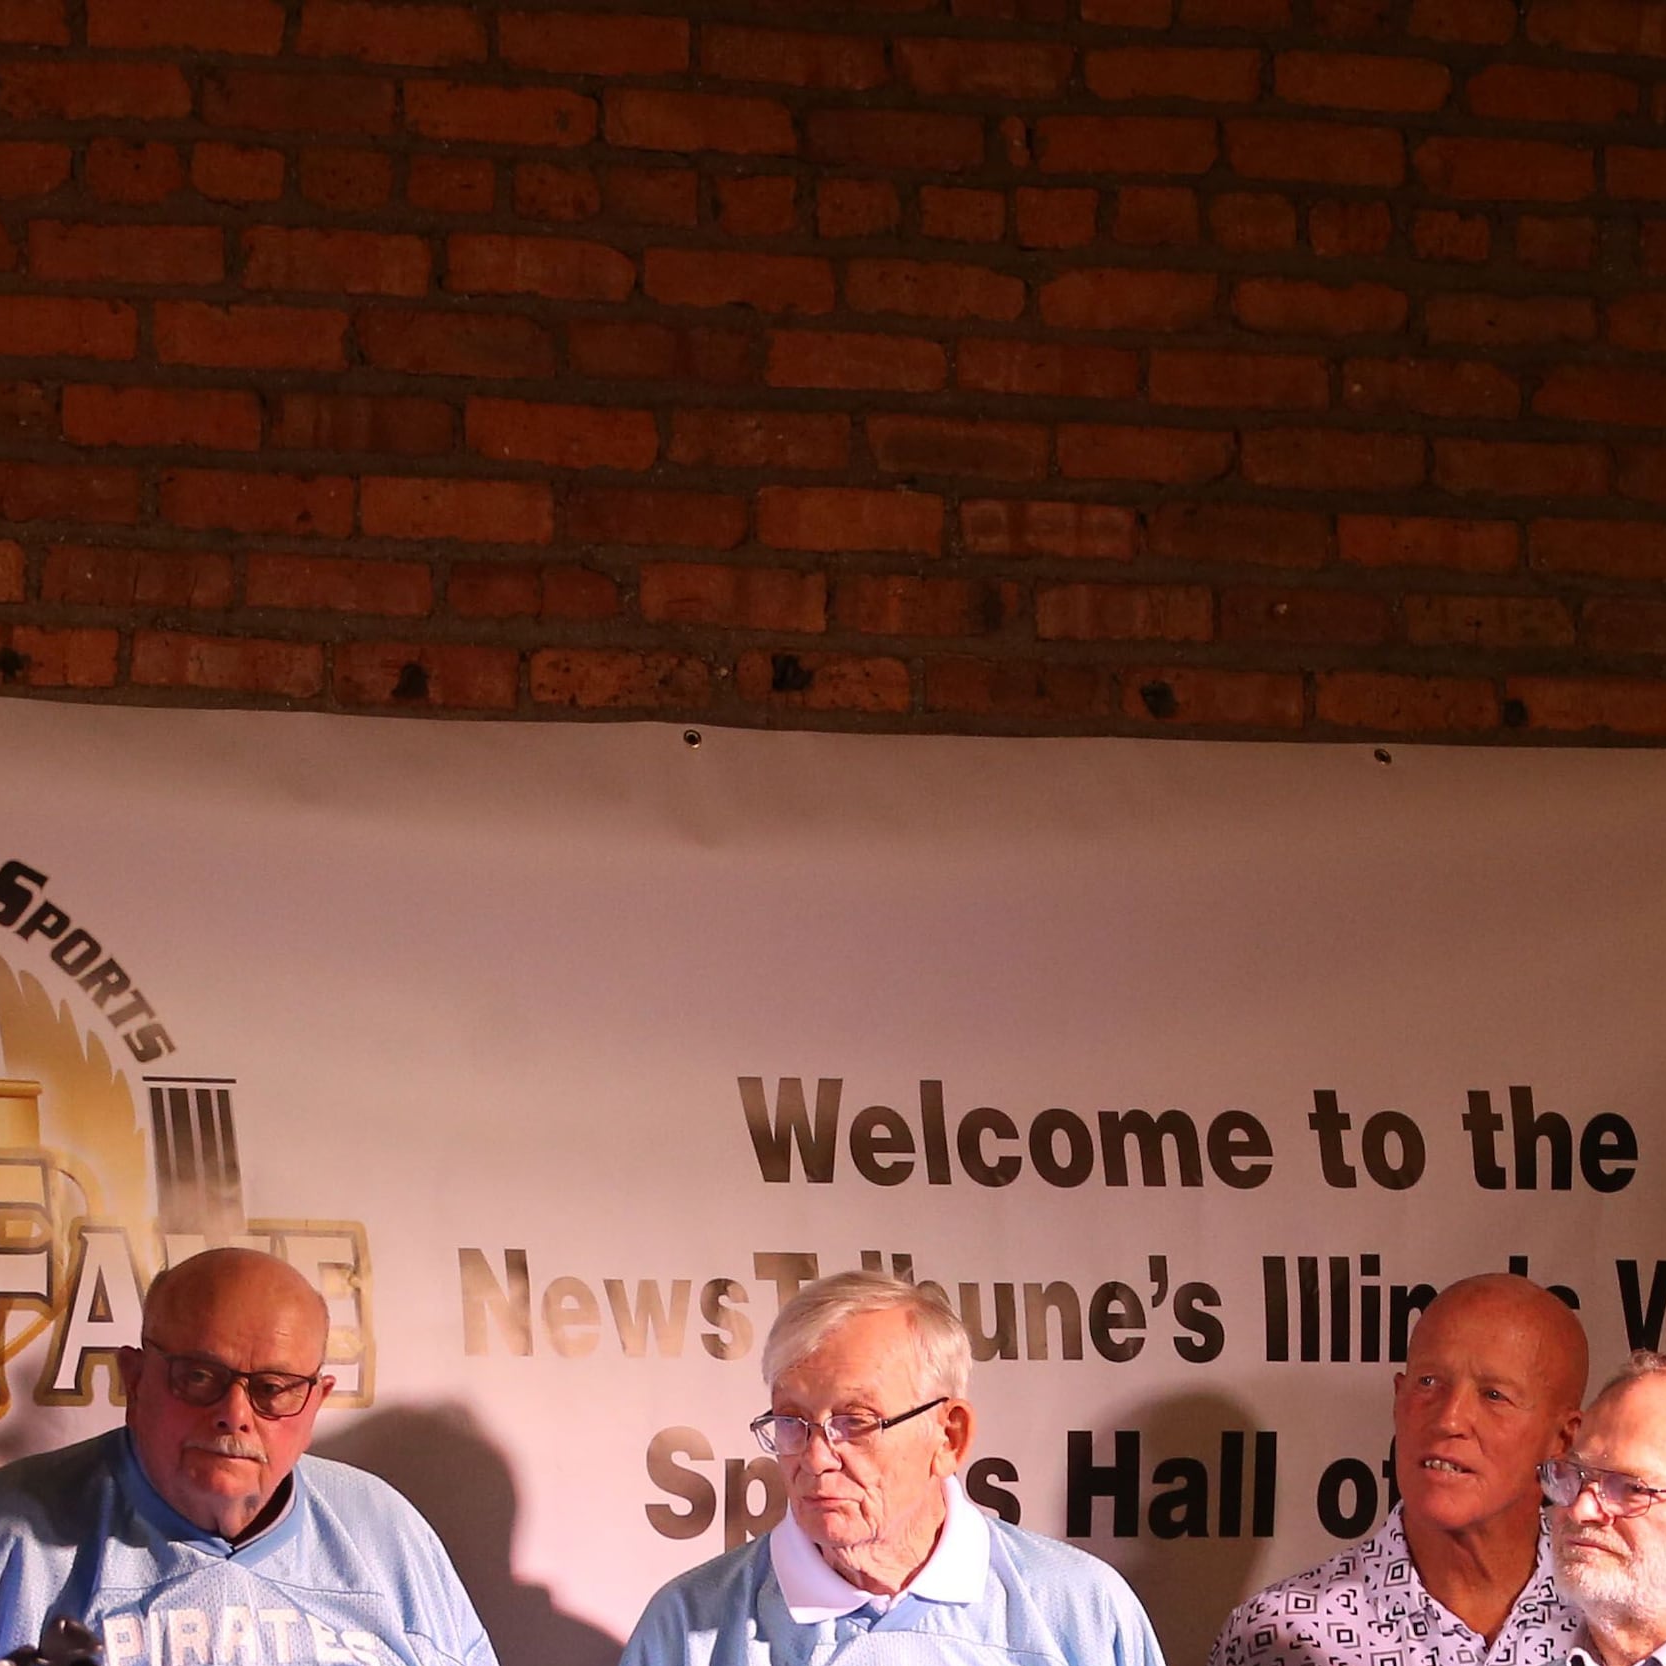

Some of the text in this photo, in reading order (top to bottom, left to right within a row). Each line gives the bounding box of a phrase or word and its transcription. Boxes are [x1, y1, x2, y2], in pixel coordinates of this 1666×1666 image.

[736, 1076, 1640, 1193] Welcome to the
[1066, 1429, 1278, 1538] Hall
